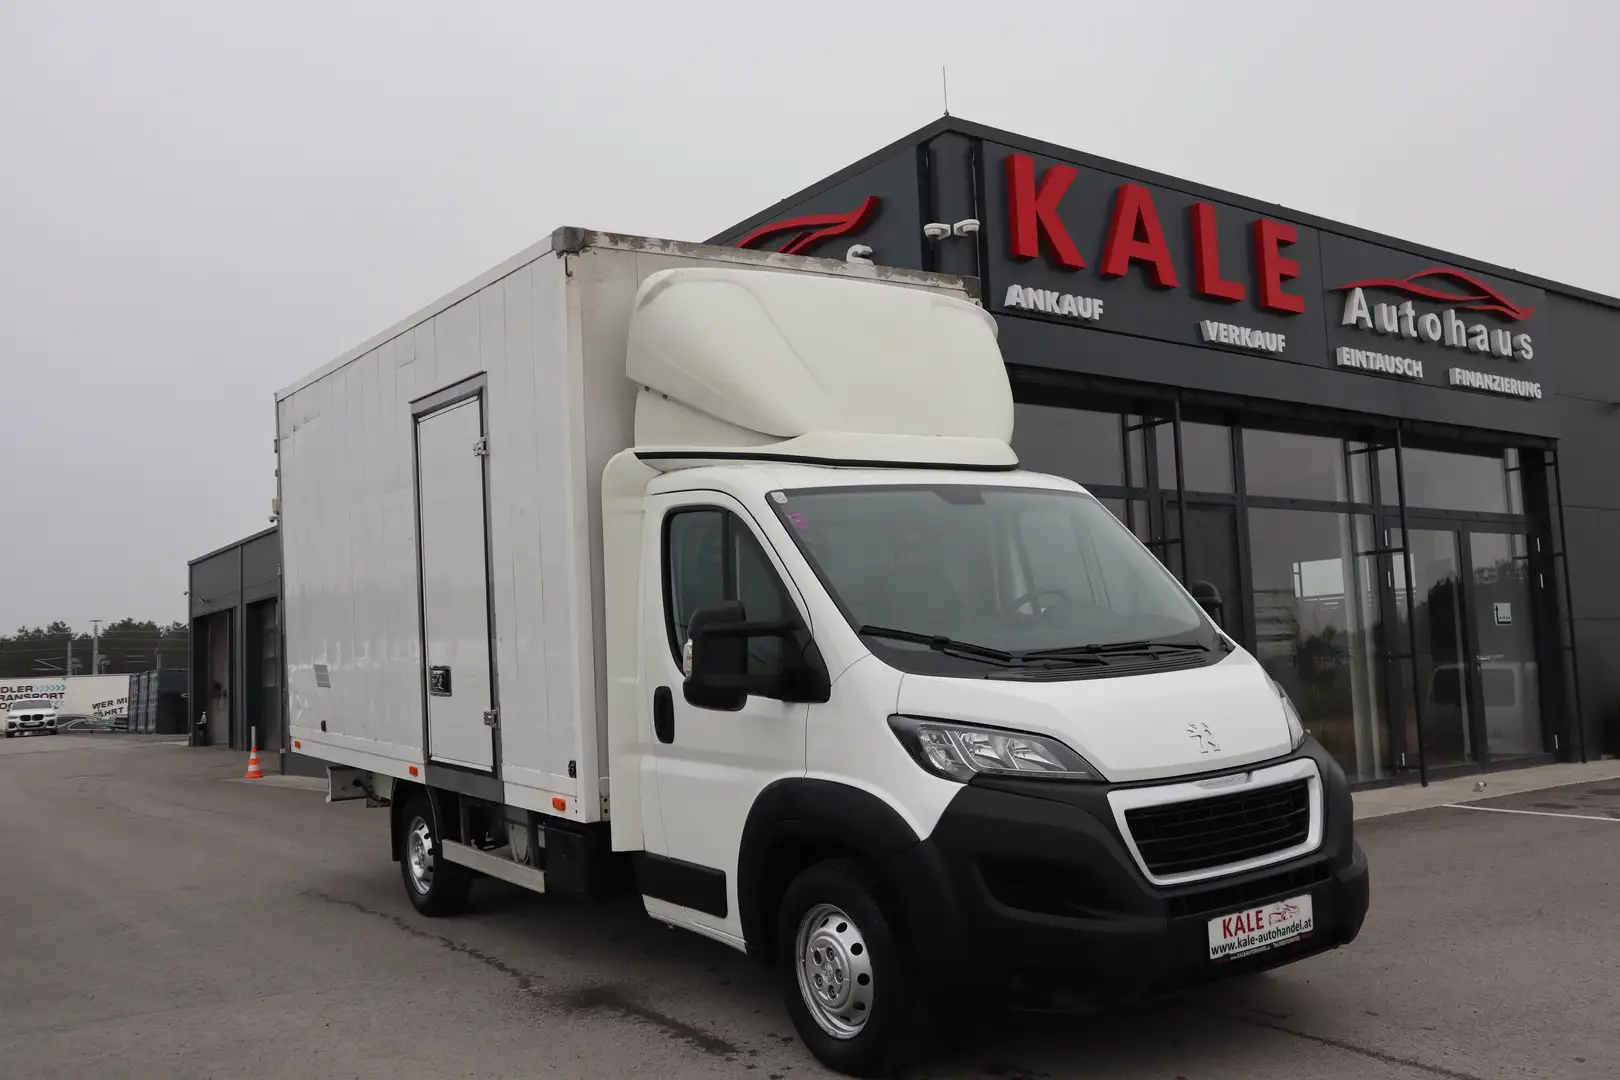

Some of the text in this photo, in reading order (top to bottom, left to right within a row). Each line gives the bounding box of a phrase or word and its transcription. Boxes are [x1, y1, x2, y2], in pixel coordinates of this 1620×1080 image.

[1006, 153, 1305, 314] KALE
[1004, 284, 1104, 321] ANKAUF
[1200, 320, 1286, 353] VERKAUF
[1342, 287, 1534, 360] Autohaus
[1337, 347, 1423, 378] EINTAUSCH
[1449, 368, 1542, 399] FINANZIERUNG
[92, 700, 114, 710] WER
[1211, 917, 1312, 956] www.kale-autohandel.at
[1222, 909, 1265, 940] KALE
